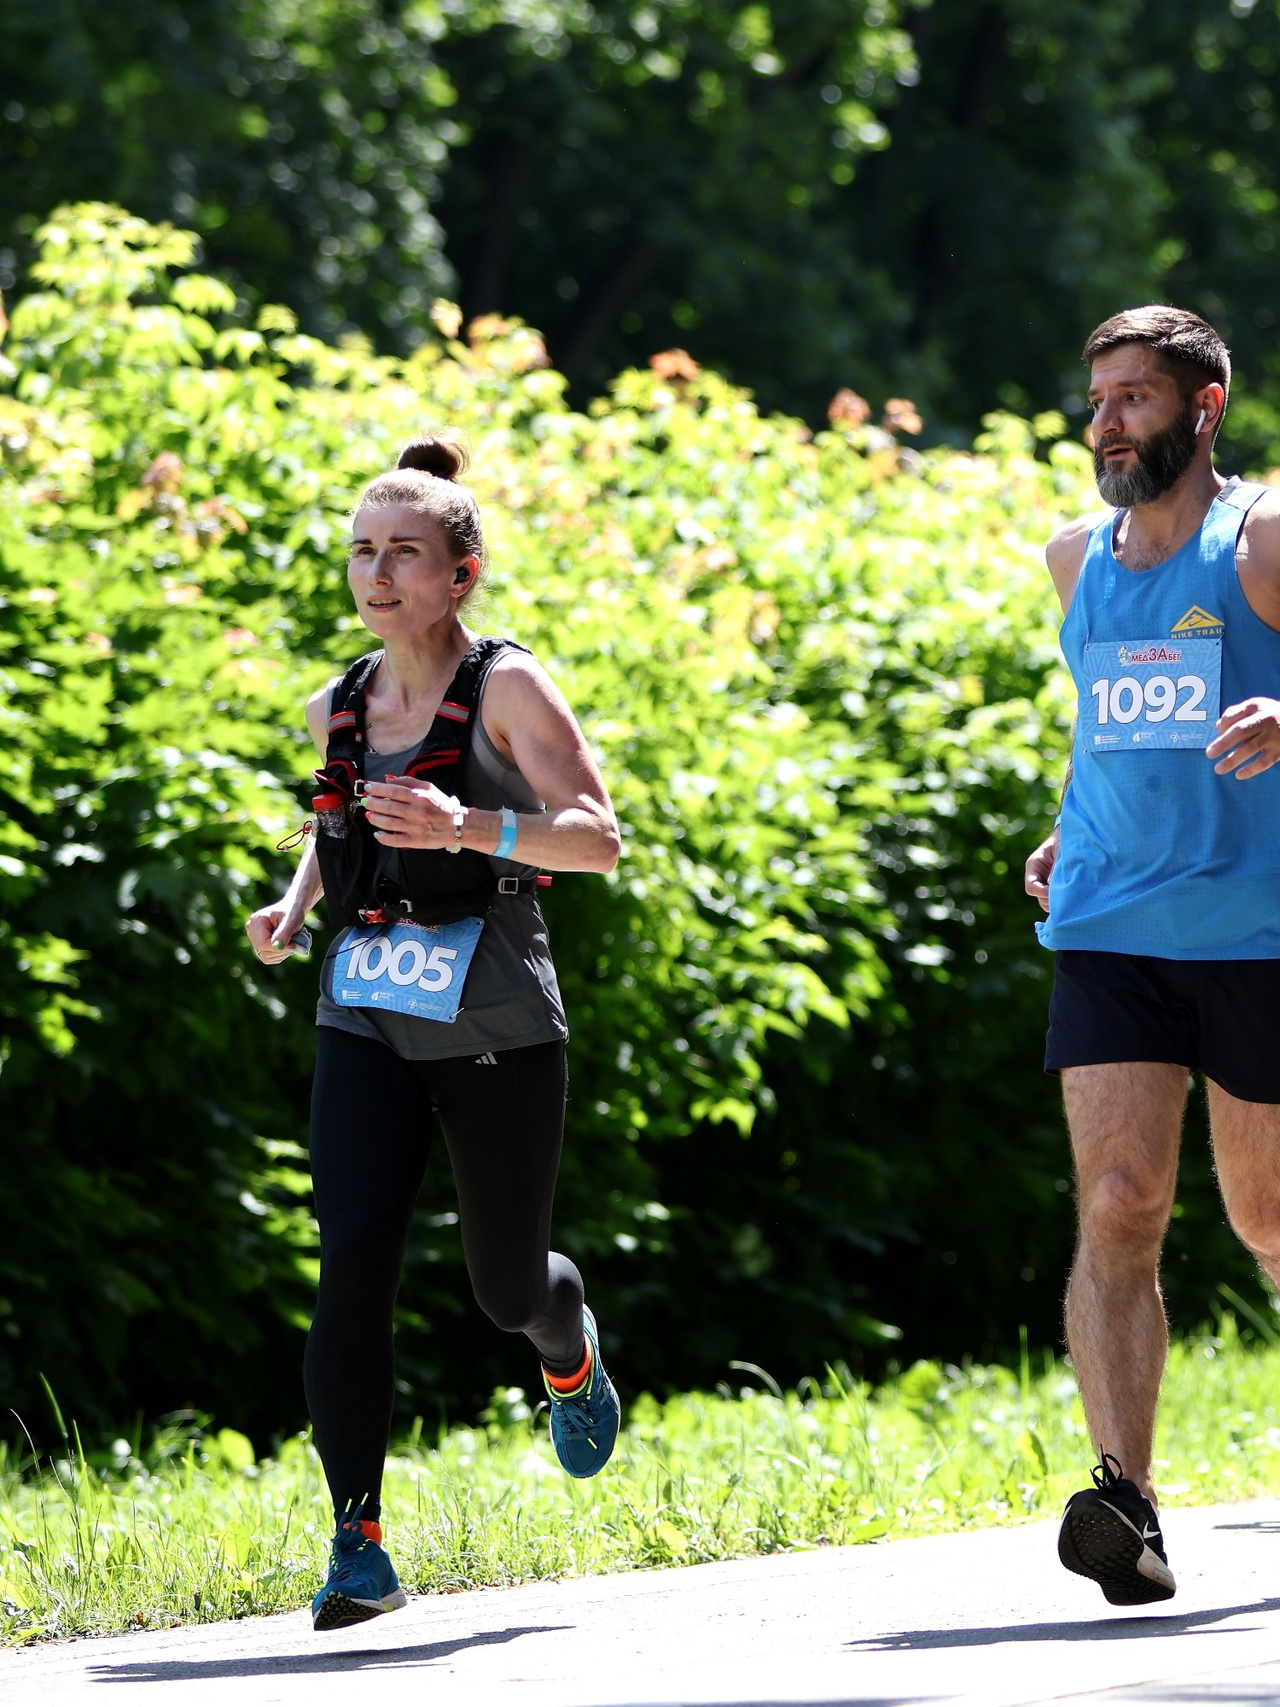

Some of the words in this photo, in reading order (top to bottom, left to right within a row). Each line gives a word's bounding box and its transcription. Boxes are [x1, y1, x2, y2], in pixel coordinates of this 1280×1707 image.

[1171, 631, 1193, 639] NIKE
[1091, 675, 1207, 724] 1092
[346, 935, 459, 993] 1005
